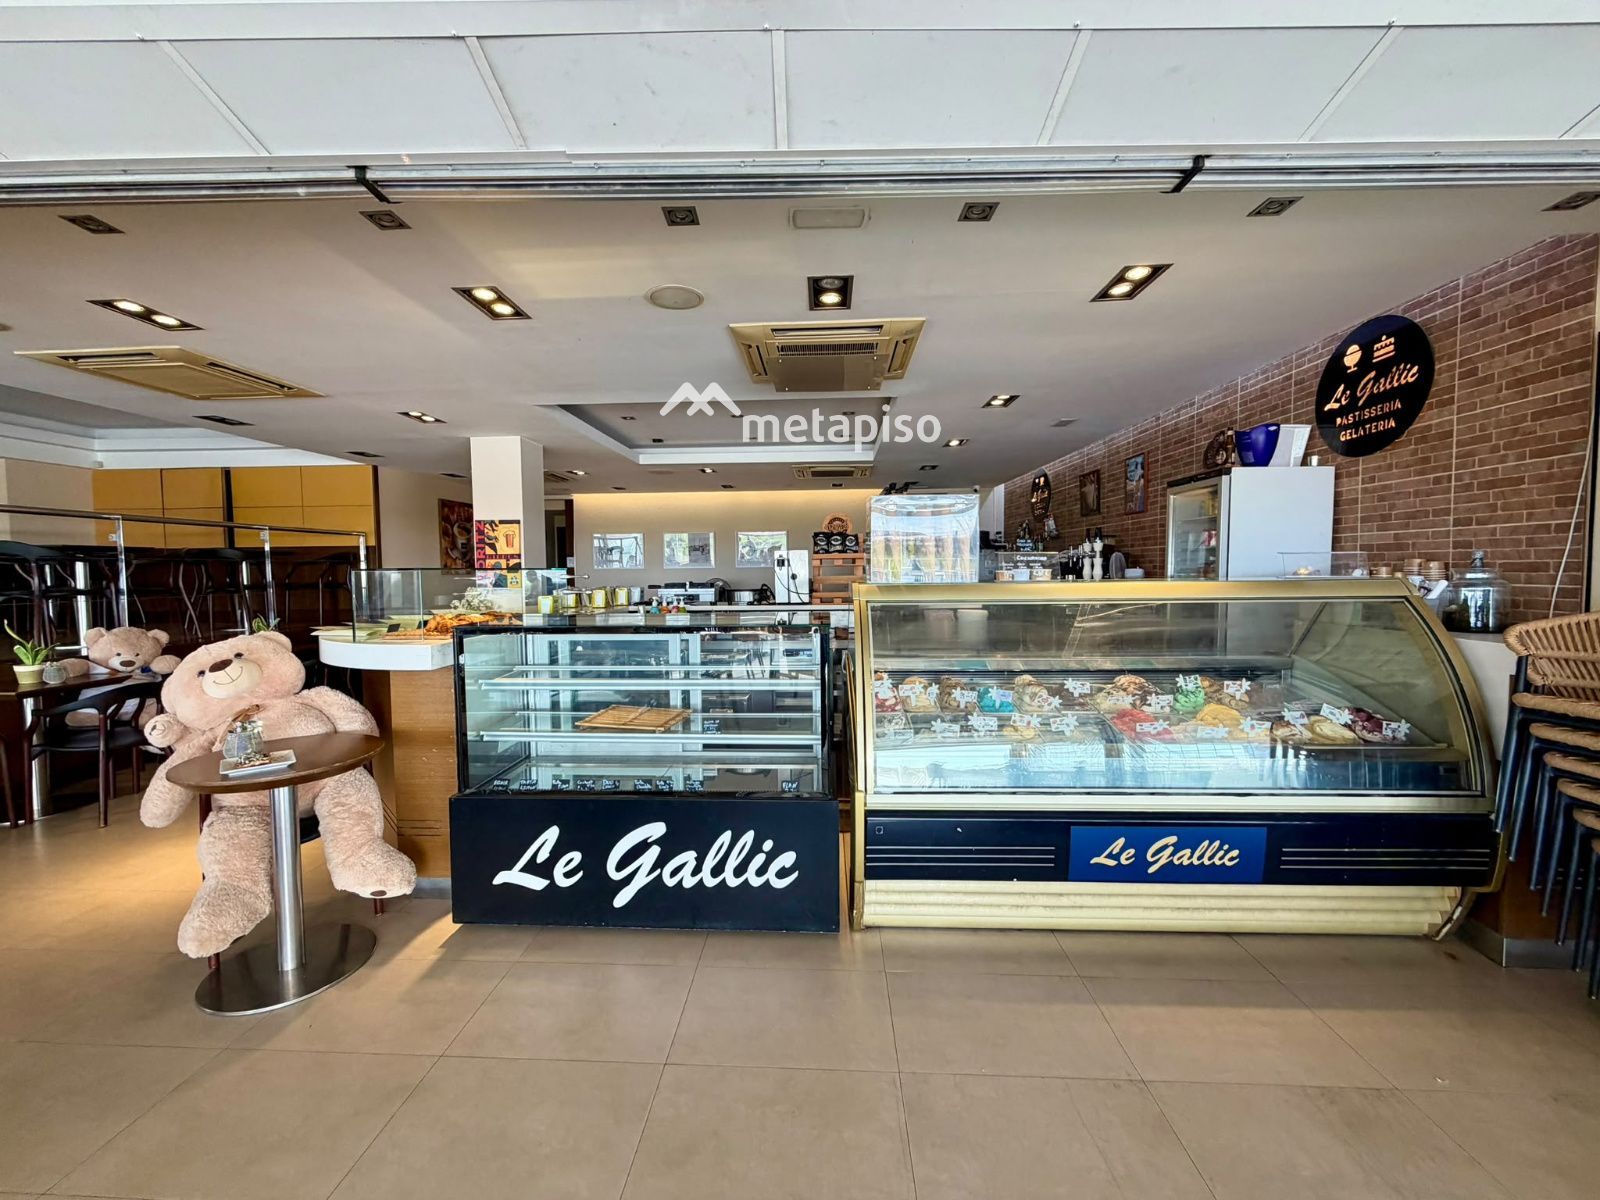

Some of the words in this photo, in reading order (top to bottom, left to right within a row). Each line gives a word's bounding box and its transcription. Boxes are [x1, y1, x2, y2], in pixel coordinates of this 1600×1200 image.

[1324, 384, 1351, 412] Le
[1356, 362, 1419, 407] Gallic
[1335, 399, 1402, 427] PASTISSERIA
[1340, 418, 1396, 442] GELATERIA
[492, 824, 584, 891] Le
[606, 821, 799, 909] Gallic
[1089, 837, 1136, 867] Le
[1146, 835, 1240, 874] Gallic
